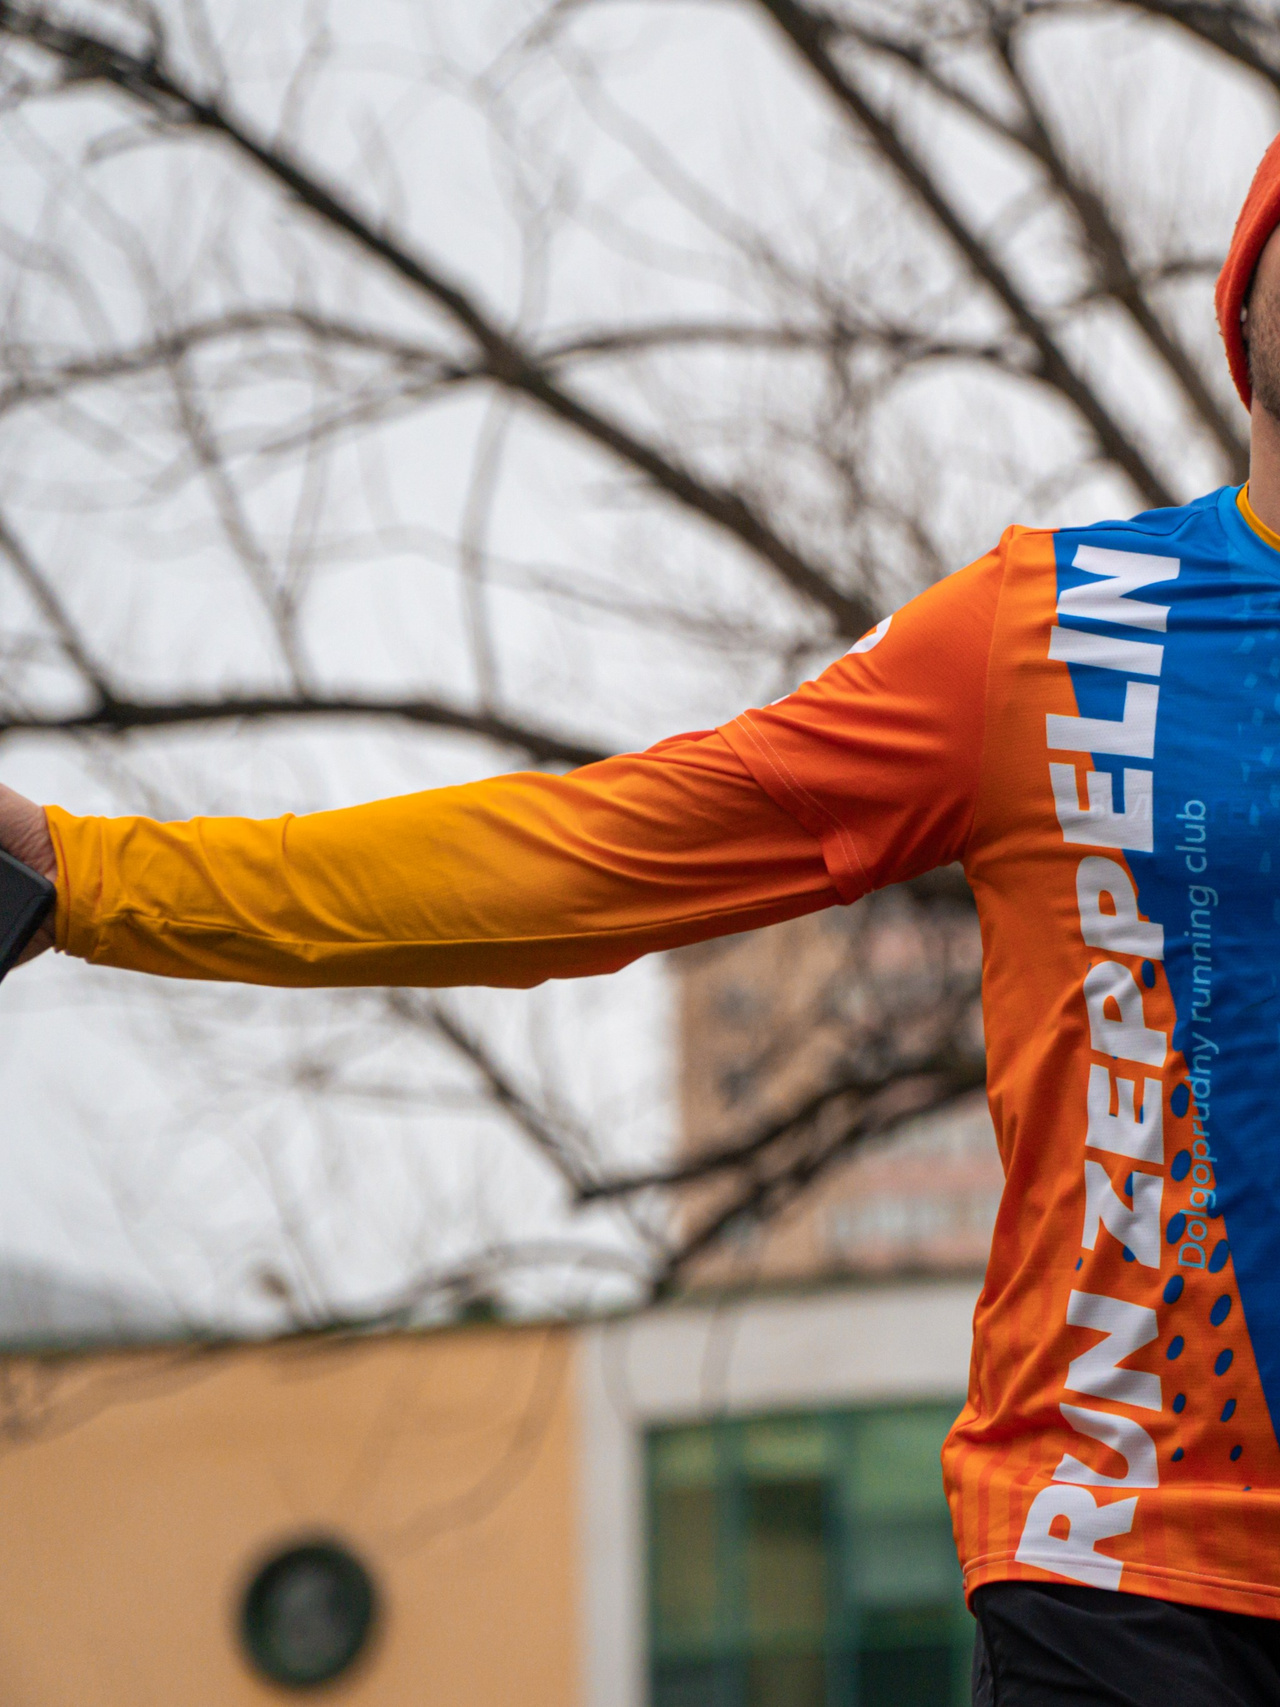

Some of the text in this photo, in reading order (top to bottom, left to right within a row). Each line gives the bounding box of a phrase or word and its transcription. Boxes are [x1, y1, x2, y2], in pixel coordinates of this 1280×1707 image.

[1045, 543, 1181, 1270] ZEPPELIN
[1175, 799, 1220, 1270] Dolgoprudny running club
[1015, 1289, 1163, 1592] RUN
